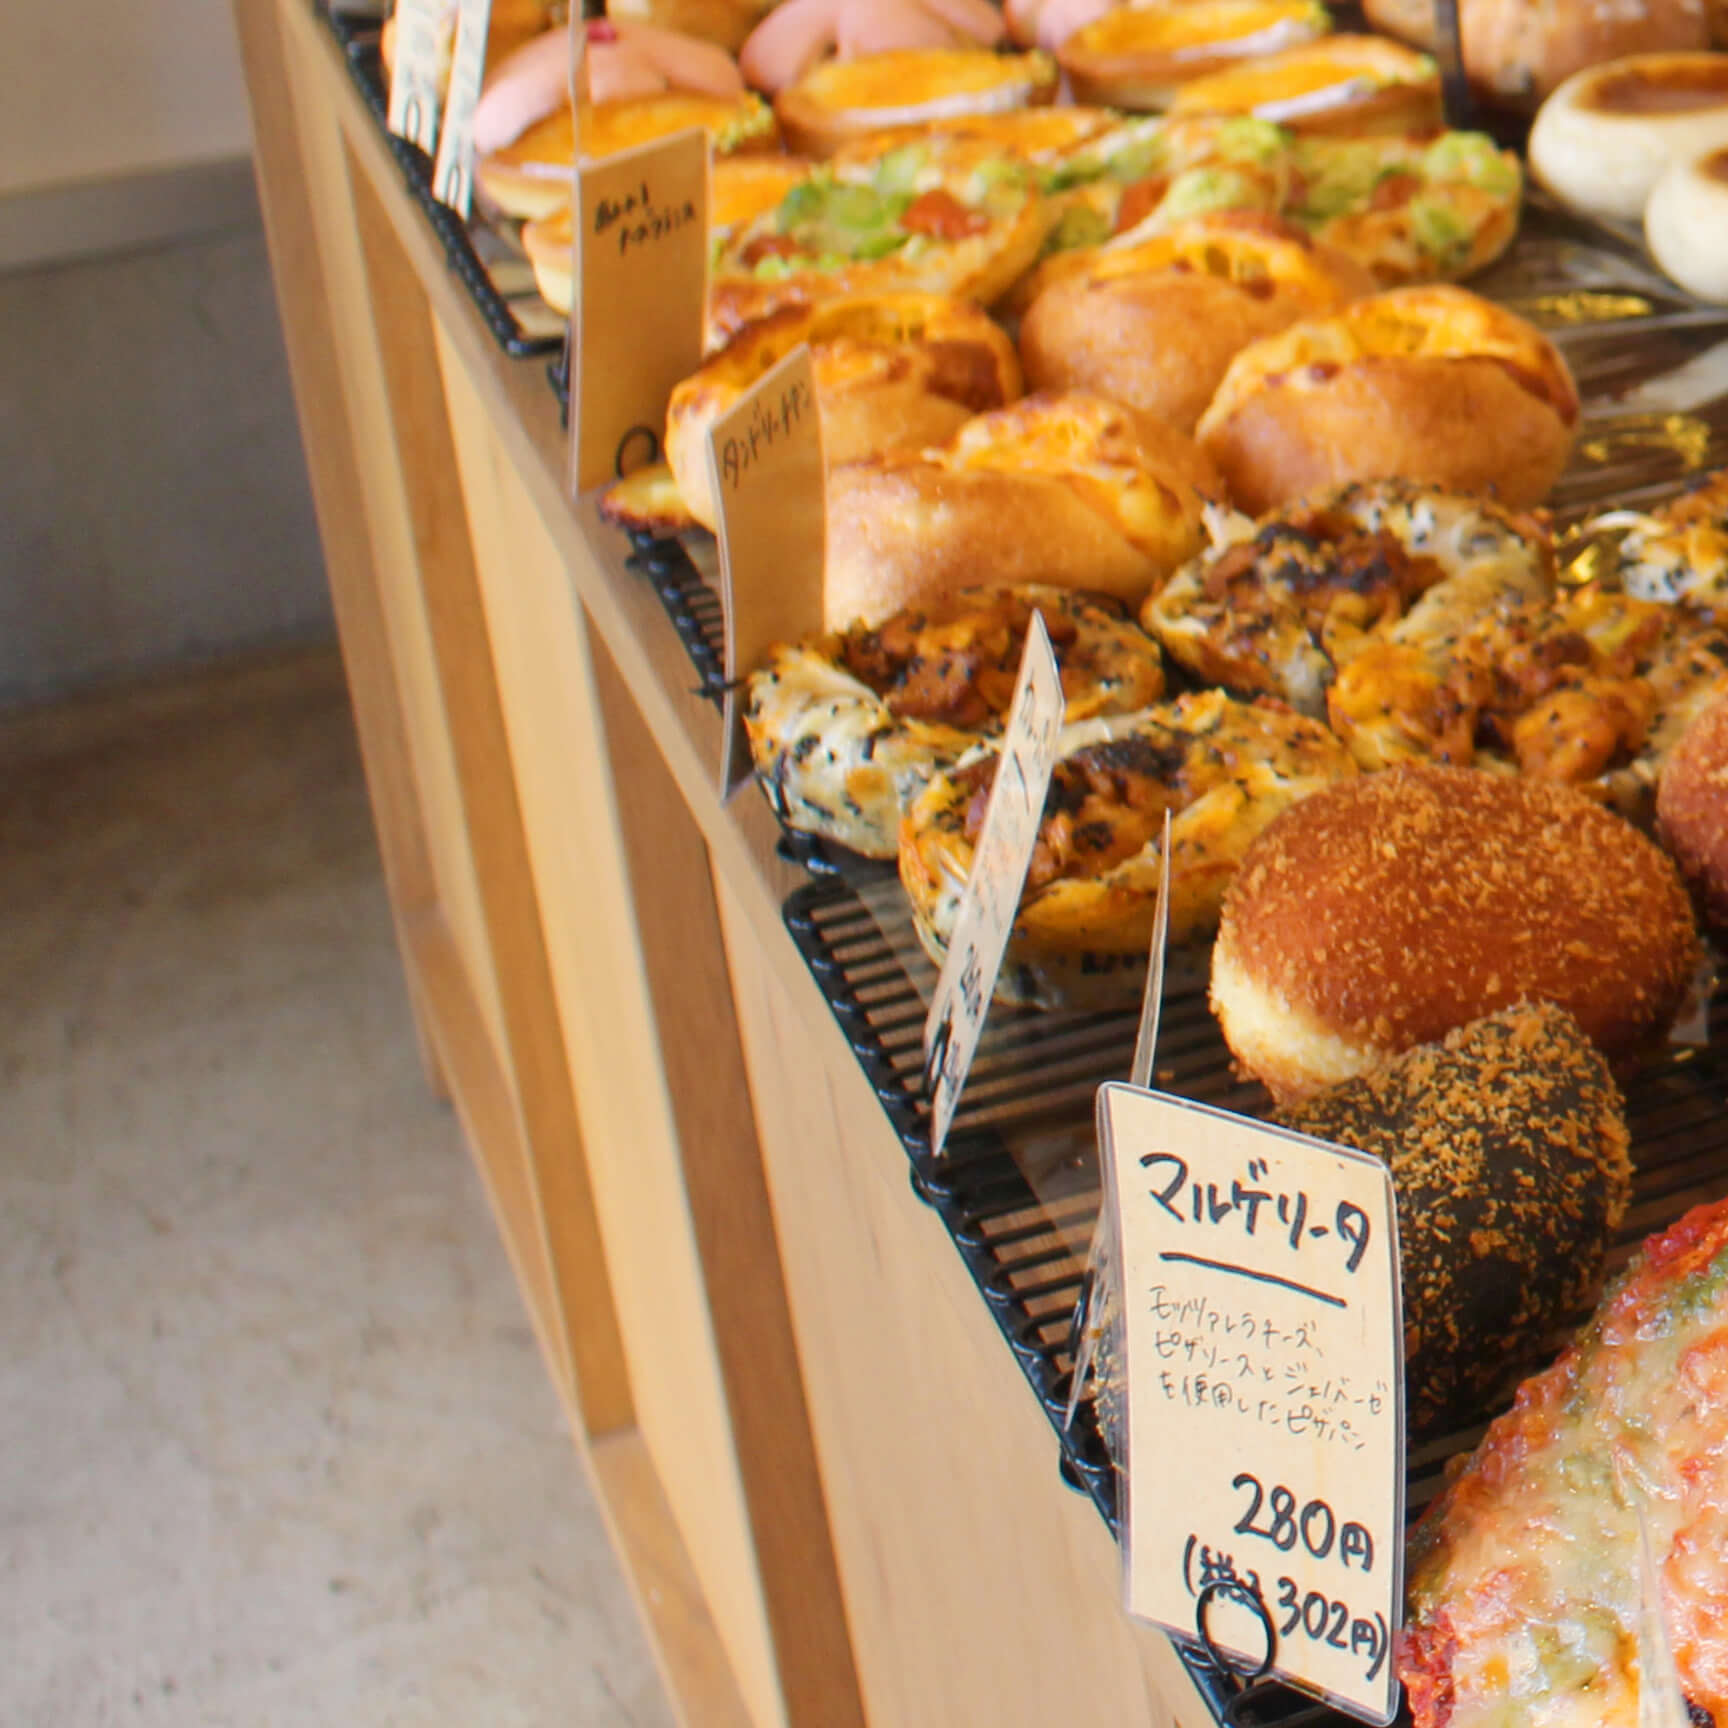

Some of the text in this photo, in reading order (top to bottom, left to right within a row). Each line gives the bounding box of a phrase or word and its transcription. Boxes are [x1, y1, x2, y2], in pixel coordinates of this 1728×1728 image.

[1138, 1151, 1372, 1274] マルゲリータ
[1154, 1329, 1390, 1417] ピザソースとジェノベーゼ
[1231, 1472, 1377, 1573] 280円
